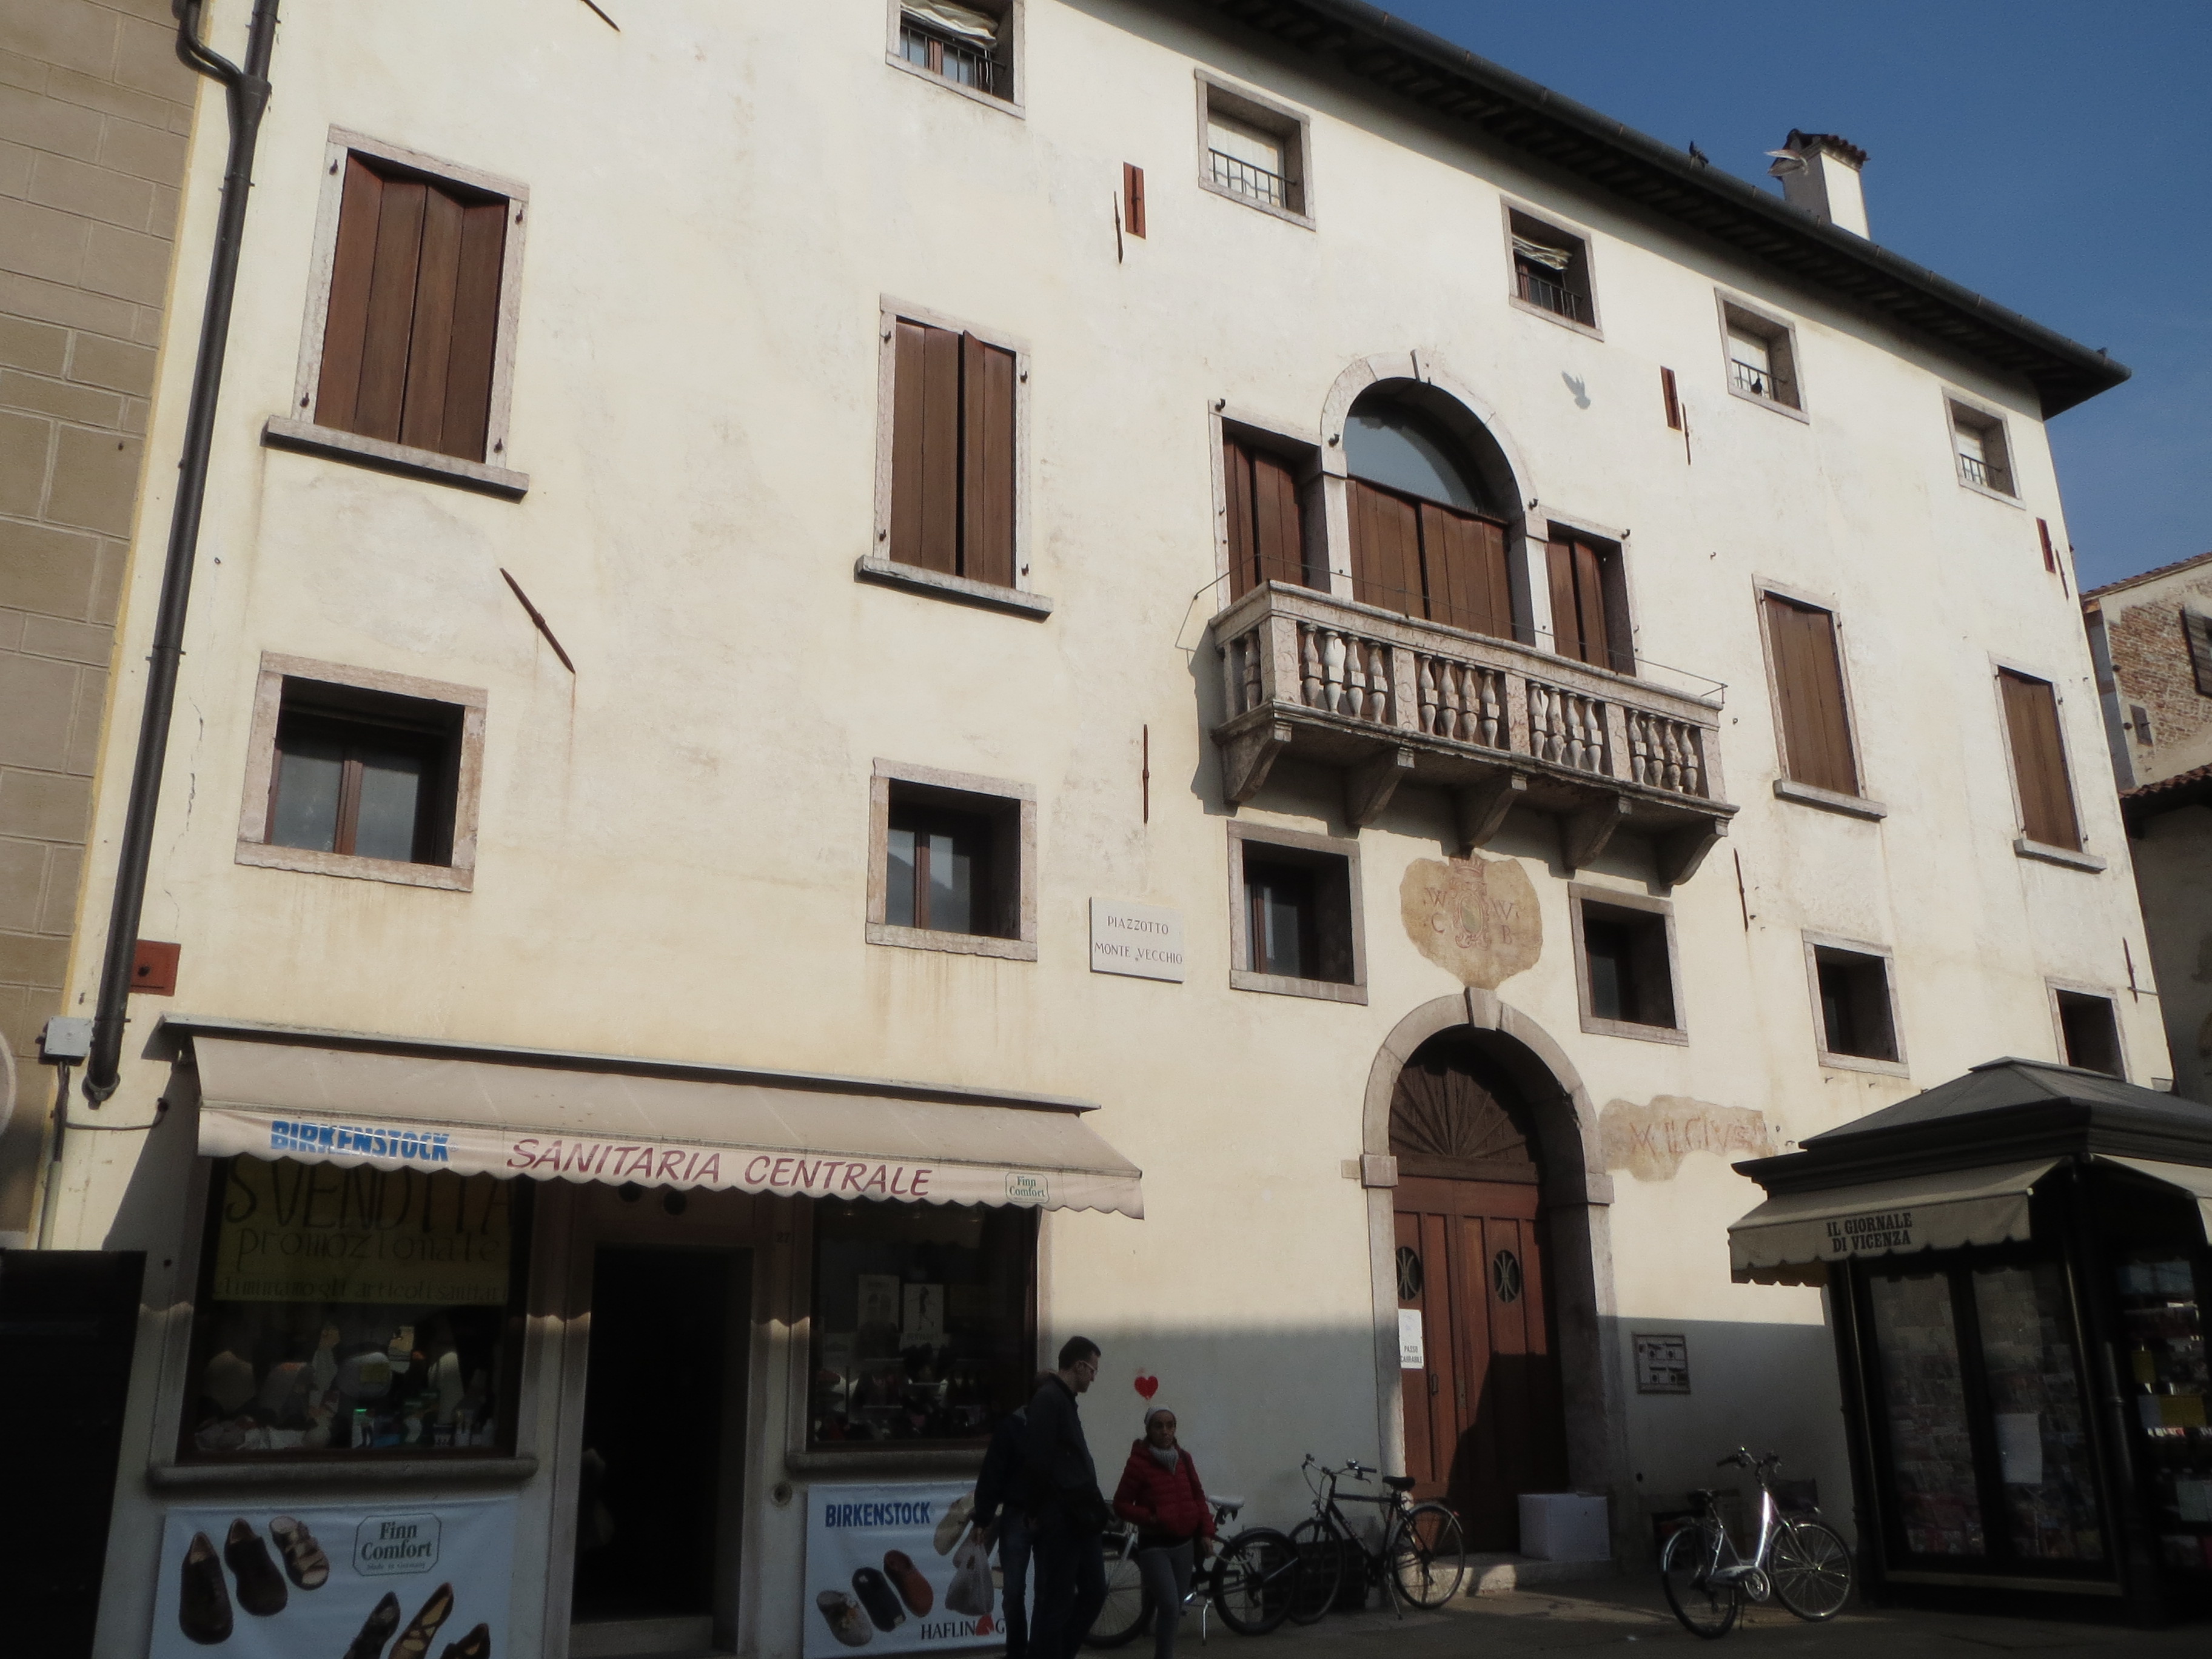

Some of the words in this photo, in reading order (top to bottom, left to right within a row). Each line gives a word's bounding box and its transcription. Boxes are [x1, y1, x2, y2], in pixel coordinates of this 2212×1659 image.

[1107, 915, 1169, 935] PIAZZOTTO
[1094, 942, 1130, 957] MONTE
[1137, 948, 1183, 965] VECCHIO
[271, 1120, 450, 1162] BIRKENSTOCK
[506, 1138, 720, 1183] SANITARIA
[745, 1155, 933, 1196] CENTRALE
[1009, 1185, 1045, 1197] Comfort
[1017, 1176, 1036, 1187] Finn
[1826, 1221, 1841, 1237] IL
[1845, 1212, 1912, 1235] GIORNALE
[1832, 1236, 1847, 1252] DI
[1851, 1230, 1911, 1250] VICENZA
[825, 1501, 930, 1527] BIRKENSTOCK
[380, 1521, 417, 1540] Finn
[361, 1539, 432, 1560] Comfort
[921, 1618, 1005, 1640] HAFLING
